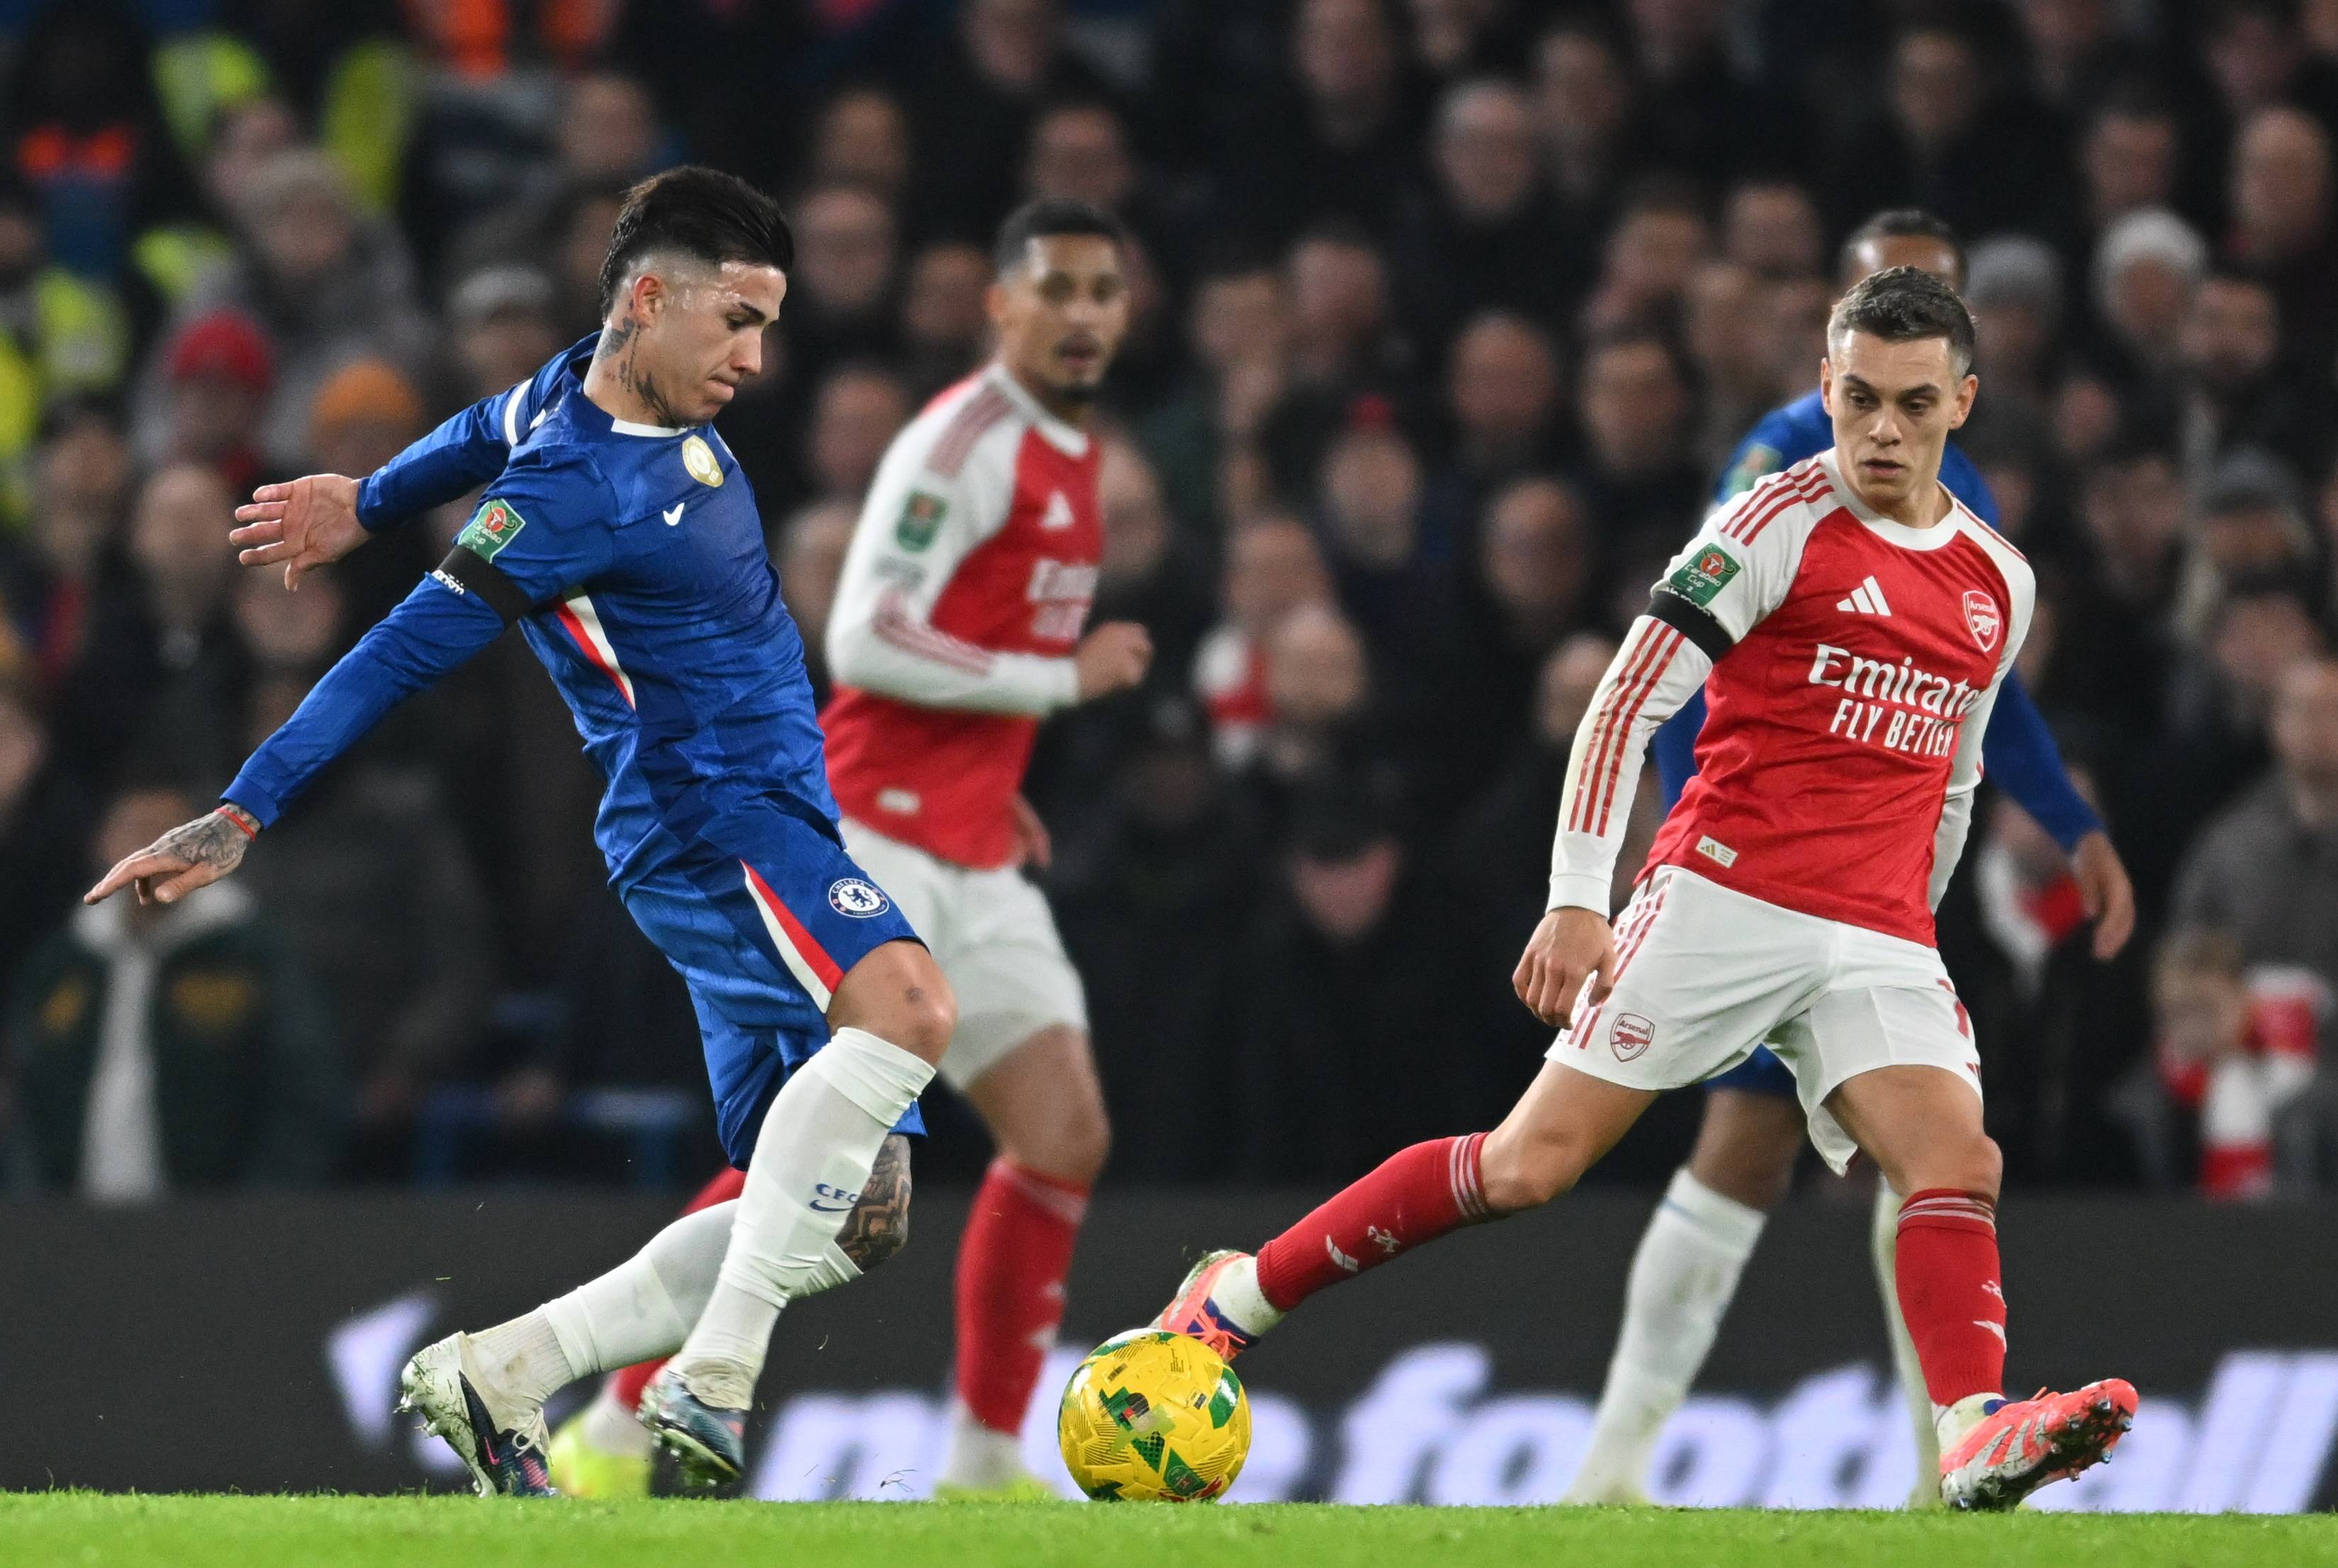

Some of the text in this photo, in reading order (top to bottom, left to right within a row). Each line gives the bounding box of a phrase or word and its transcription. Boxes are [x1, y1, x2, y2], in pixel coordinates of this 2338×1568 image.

[471, 531, 486, 544] Cup
[1685, 563, 1721, 587] Carabao
[1687, 575, 1705, 587] Cup
[1809, 643, 1982, 718] Emirate
[1830, 699, 1884, 743] FLY
[832, 879, 864, 893] CHELSEA
[1619, 1020, 1648, 1034] Arsenal
[816, 1183, 859, 1203] CFC
